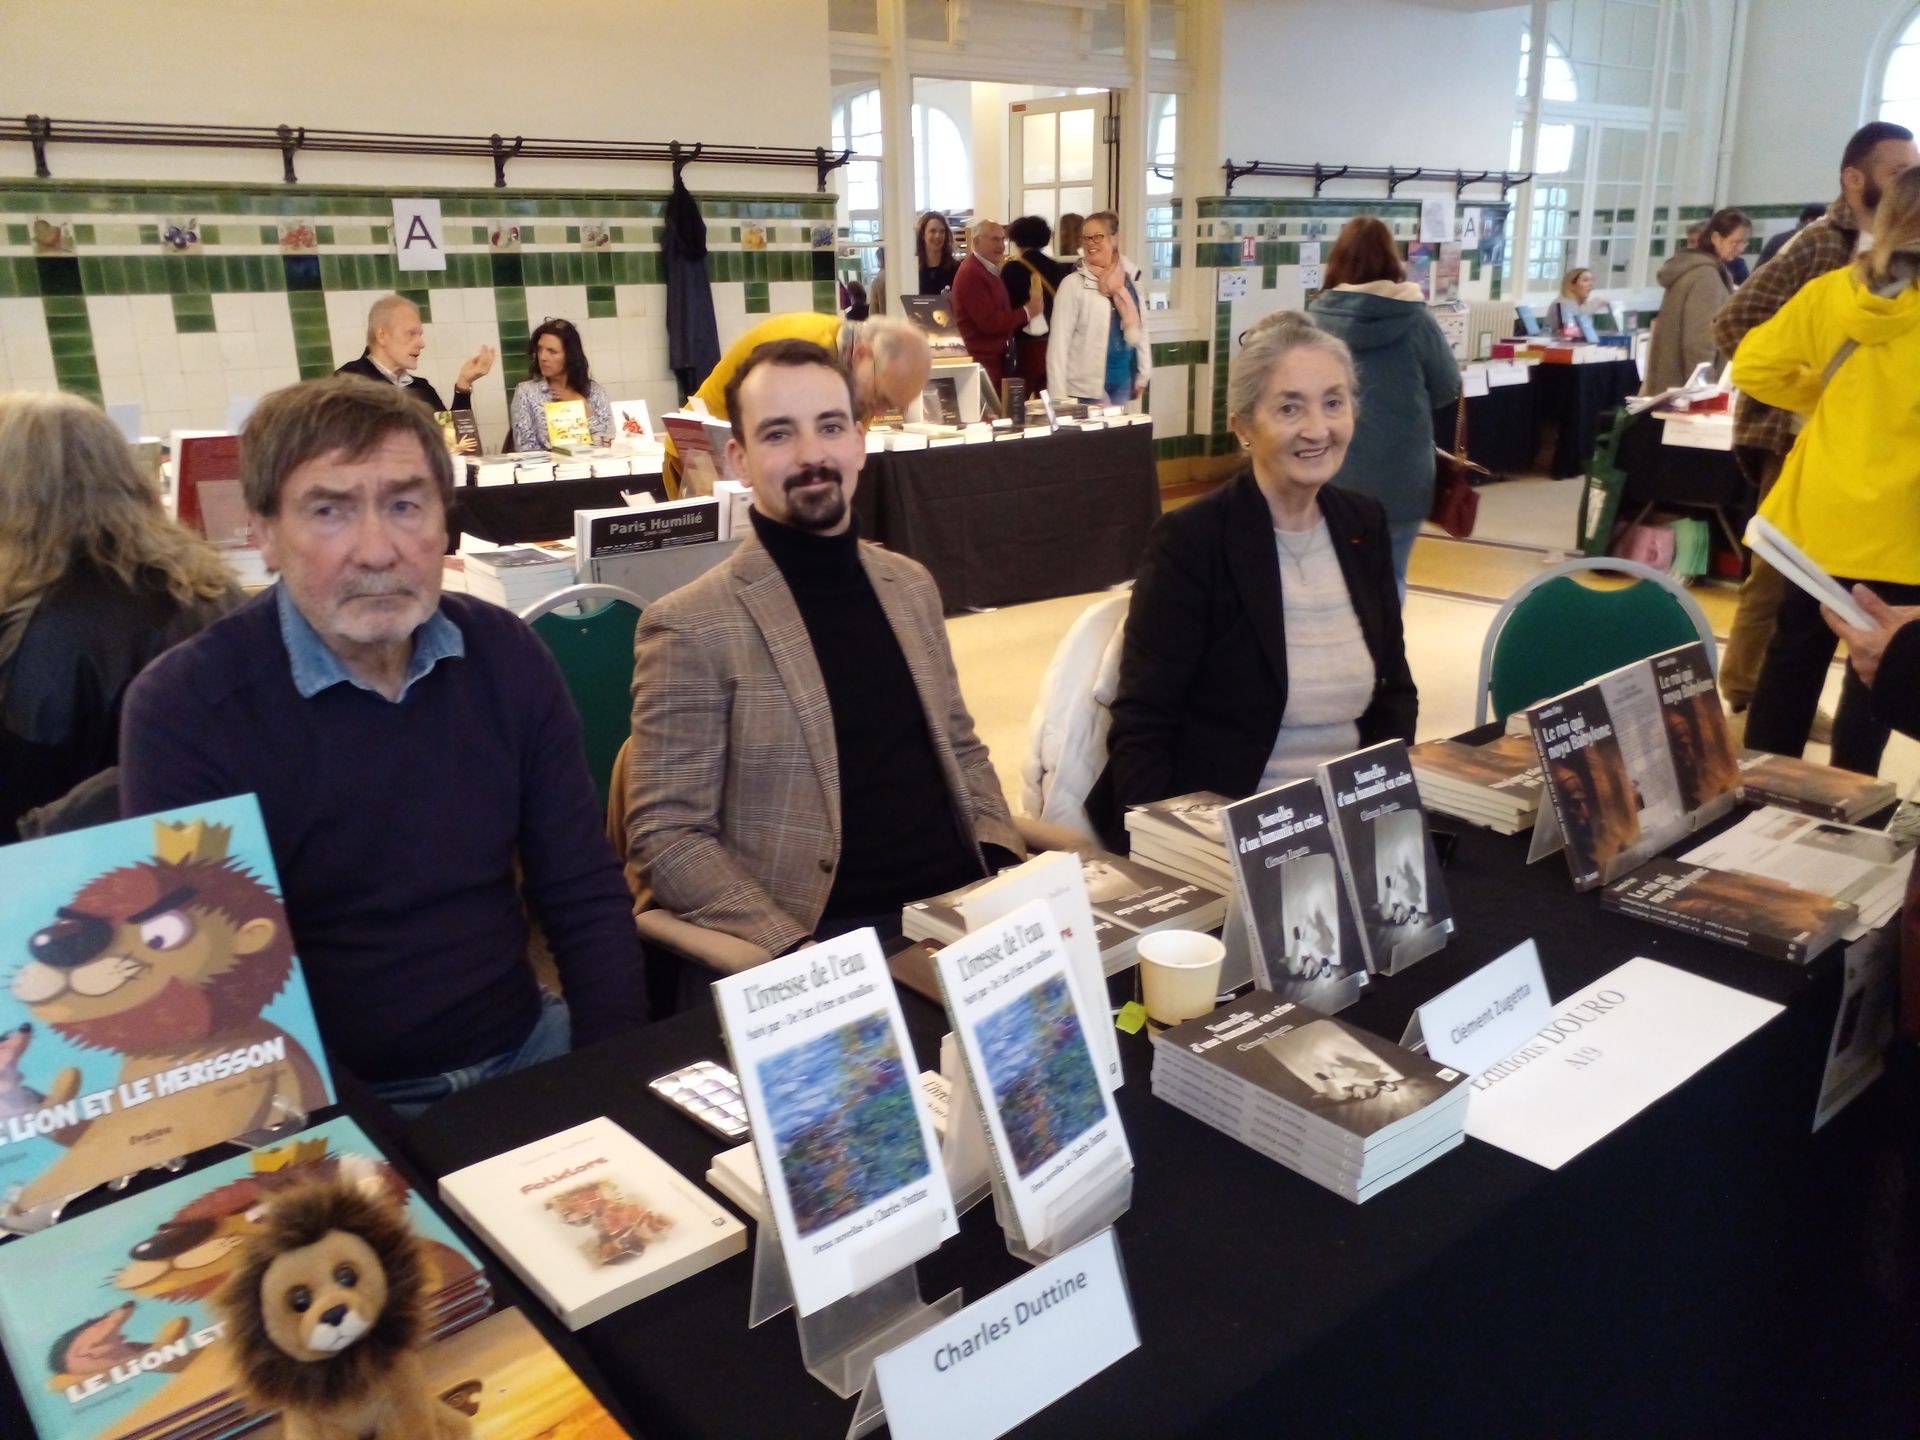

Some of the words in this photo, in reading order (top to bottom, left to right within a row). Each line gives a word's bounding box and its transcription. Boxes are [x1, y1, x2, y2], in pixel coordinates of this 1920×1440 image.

[404, 215, 438, 249] A
[1463, 217, 1476, 237] A
[610, 520, 646, 535] Paris
[651, 512, 703, 531] Humilié
[1542, 727, 1556, 743] Le
[1003, 930, 1018, 955] de
[743, 973, 809, 1014] L'ivresse
[811, 962, 829, 987] de
[1450, 1008, 1494, 1045] Clément
[1537, 990, 1627, 1045] DOURO
[80, 1088, 115, 1118] ET
[119, 1078, 154, 1109] LE
[934, 1317, 1011, 1372] Charles
[1014, 1272, 1088, 1326] Duttine
[65, 1373, 107, 1404] LE
[189, 1320, 227, 1349] ET
